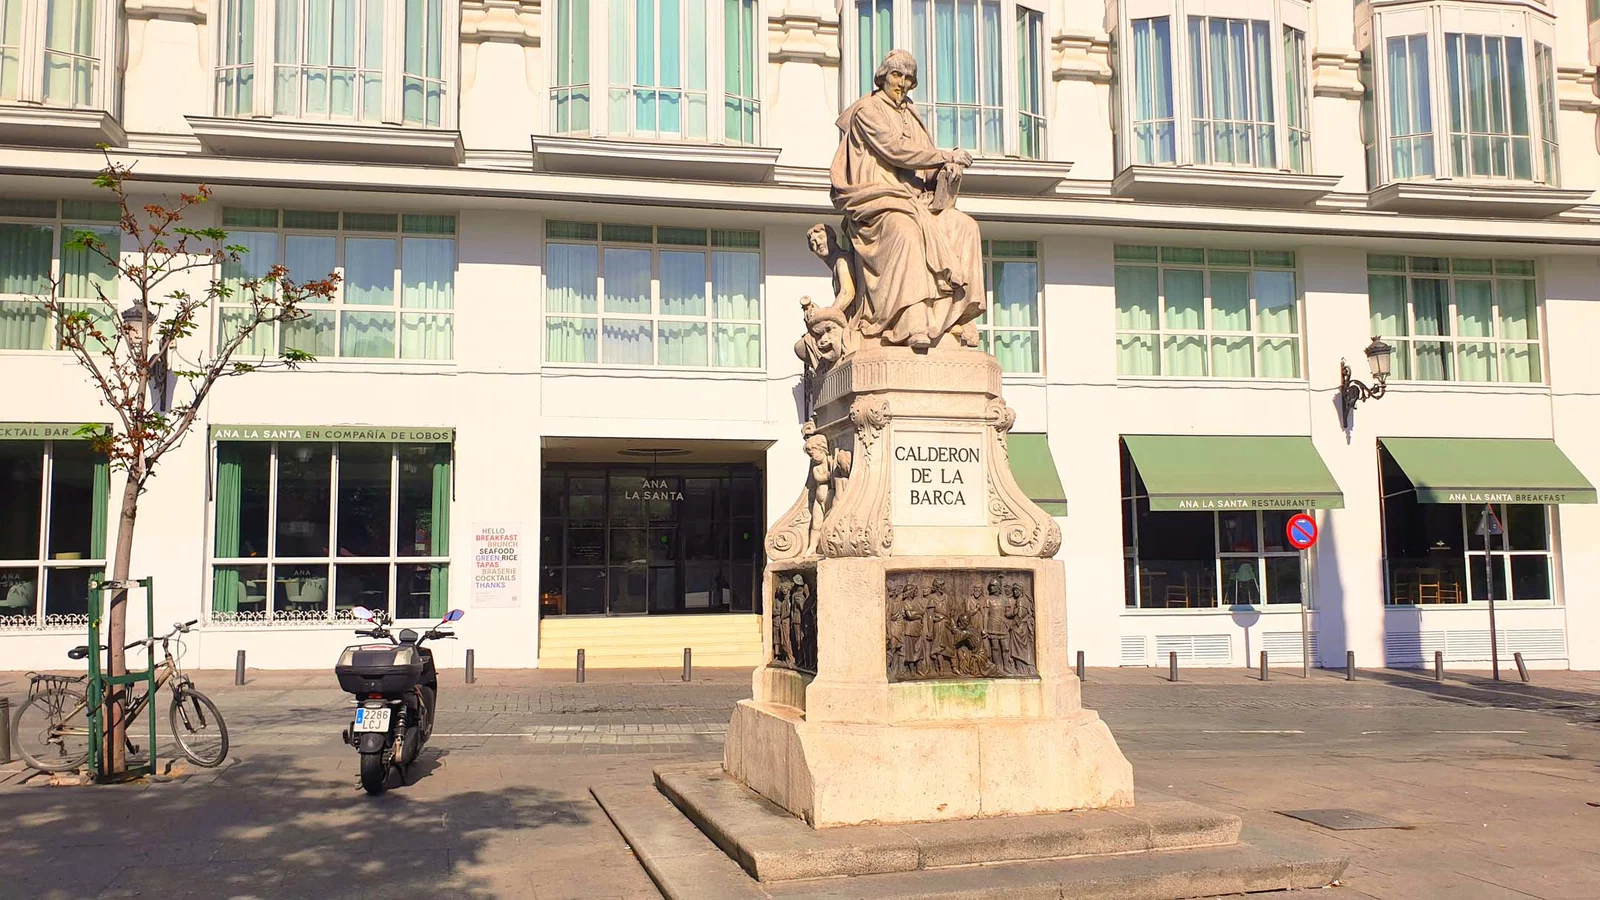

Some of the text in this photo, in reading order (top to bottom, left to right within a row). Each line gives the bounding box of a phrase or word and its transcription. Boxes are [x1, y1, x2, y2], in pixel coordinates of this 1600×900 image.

[44, 428, 69, 437] BAR
[215, 429, 449, 440] ANA LA SANTA EN COMPAÑÍA DE LOBOS
[895, 446, 980, 462] CALDERON
[911, 468, 964, 484] DE LA
[642, 480, 668, 489] ANA
[625, 490, 684, 501] LA SANTA
[910, 490, 966, 505] BARCA
[1448, 493, 1467, 501] ANA
[1179, 499, 1316, 508] ANA LA SANTA RESTAURANTE
[364, 710, 389, 720] 2286
[362, 720, 382, 730] LCJ
